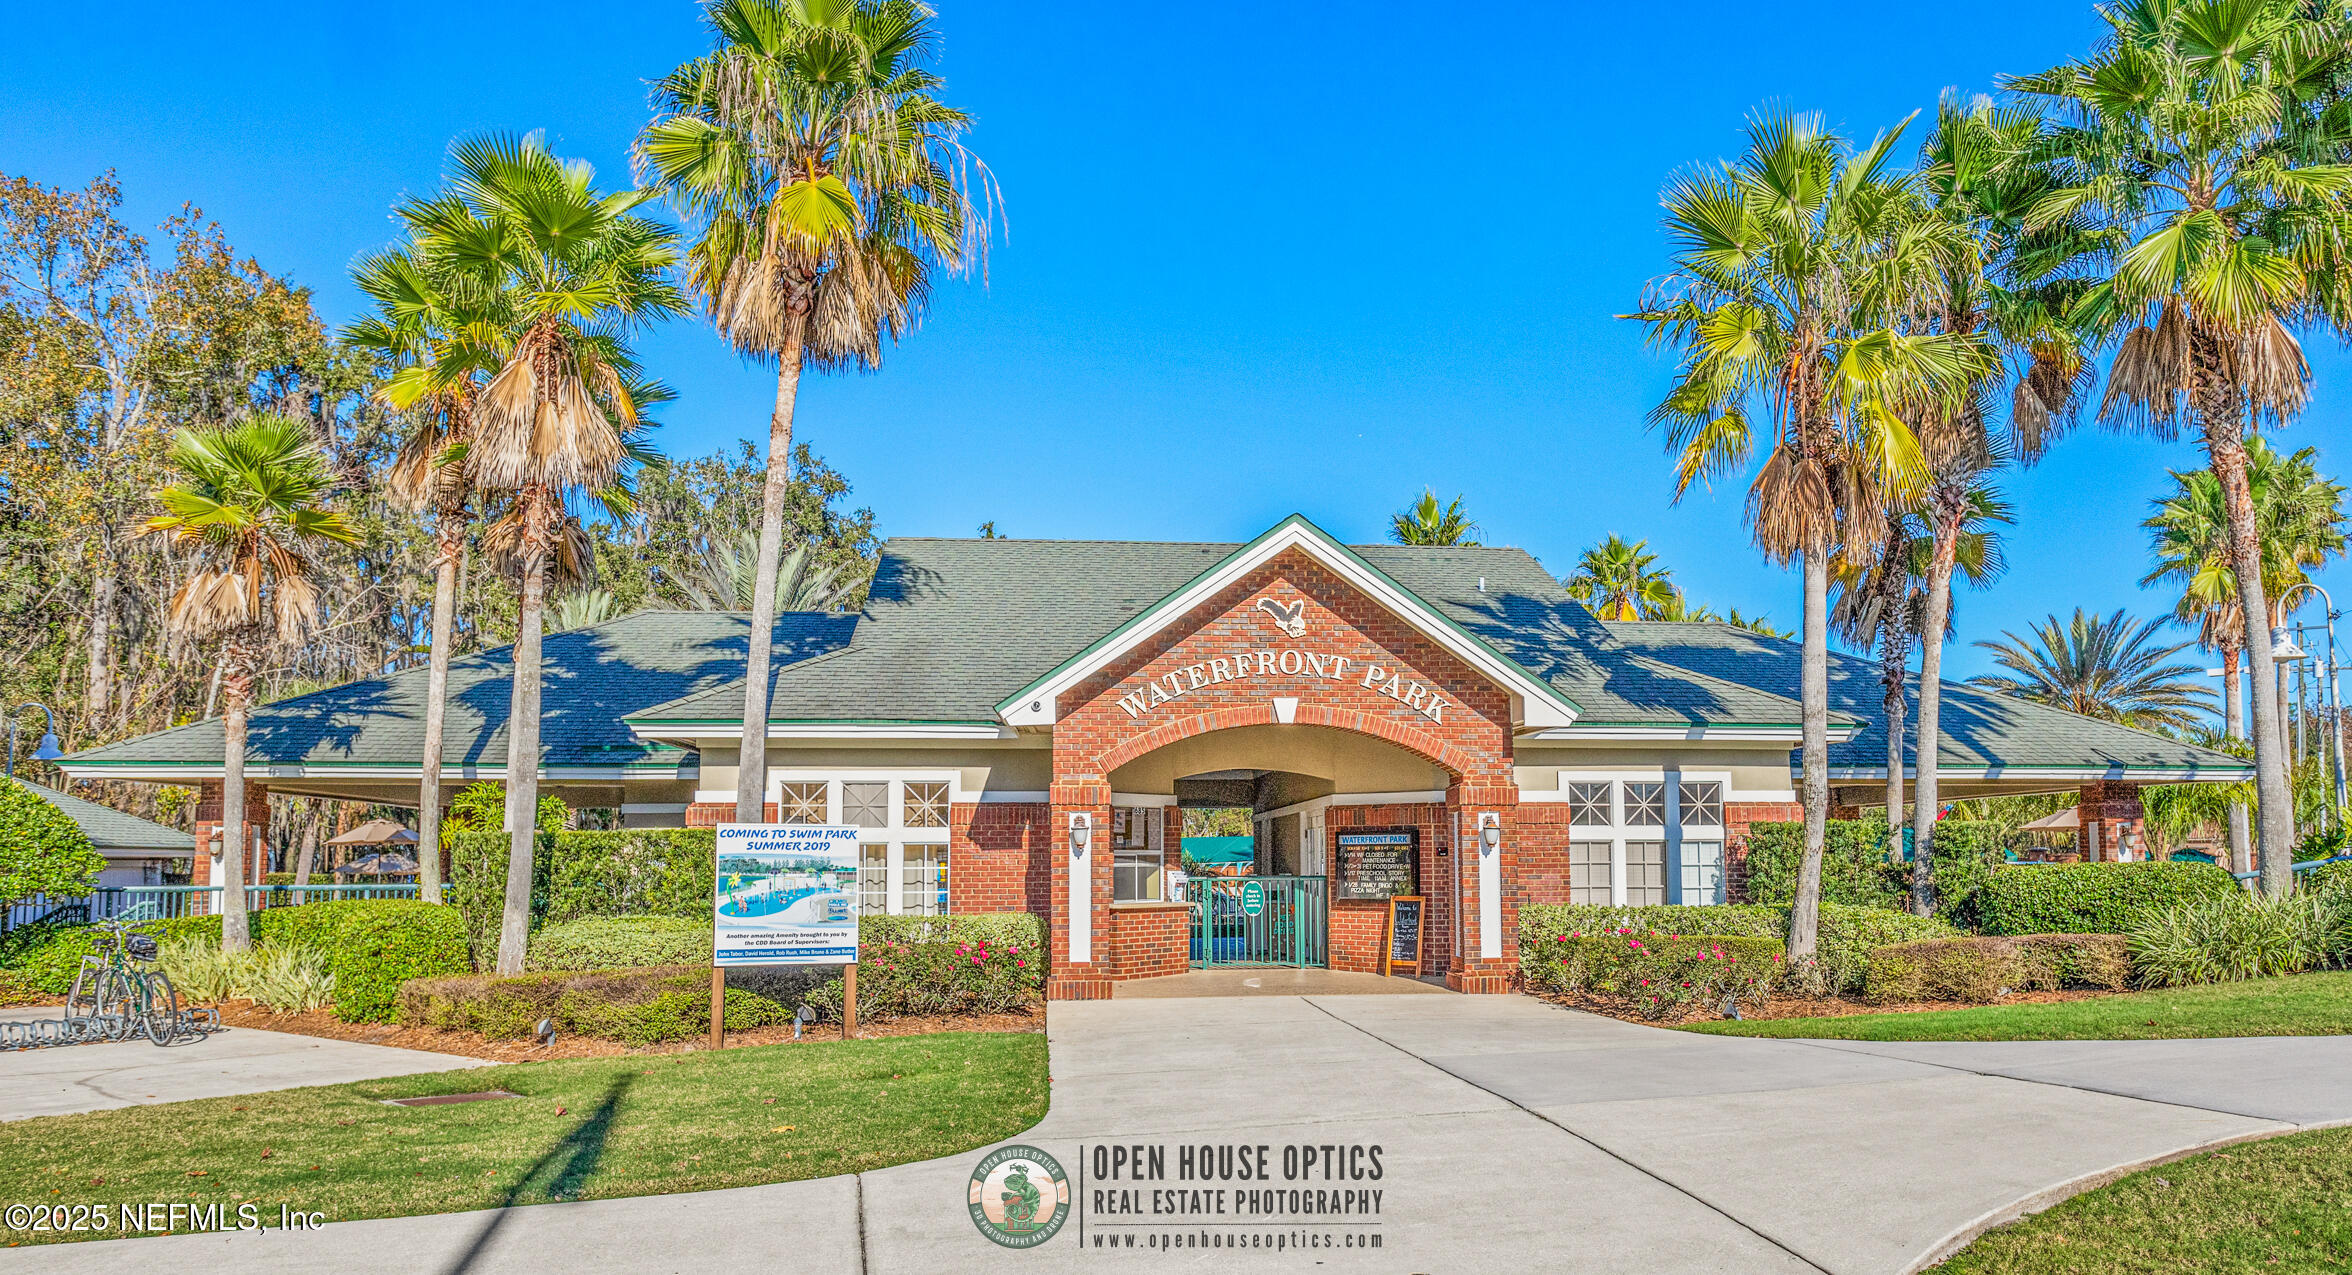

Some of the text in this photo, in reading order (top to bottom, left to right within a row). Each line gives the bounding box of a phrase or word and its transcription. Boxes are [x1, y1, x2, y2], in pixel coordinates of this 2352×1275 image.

[1115, 650, 1452, 725] WATERFRONT PARK
[720, 829, 857, 839] COMING TO SWIM PARK
[1341, 835, 1408, 844] WATERFRONT PARK
[746, 841, 831, 851] SUMMER 2019
